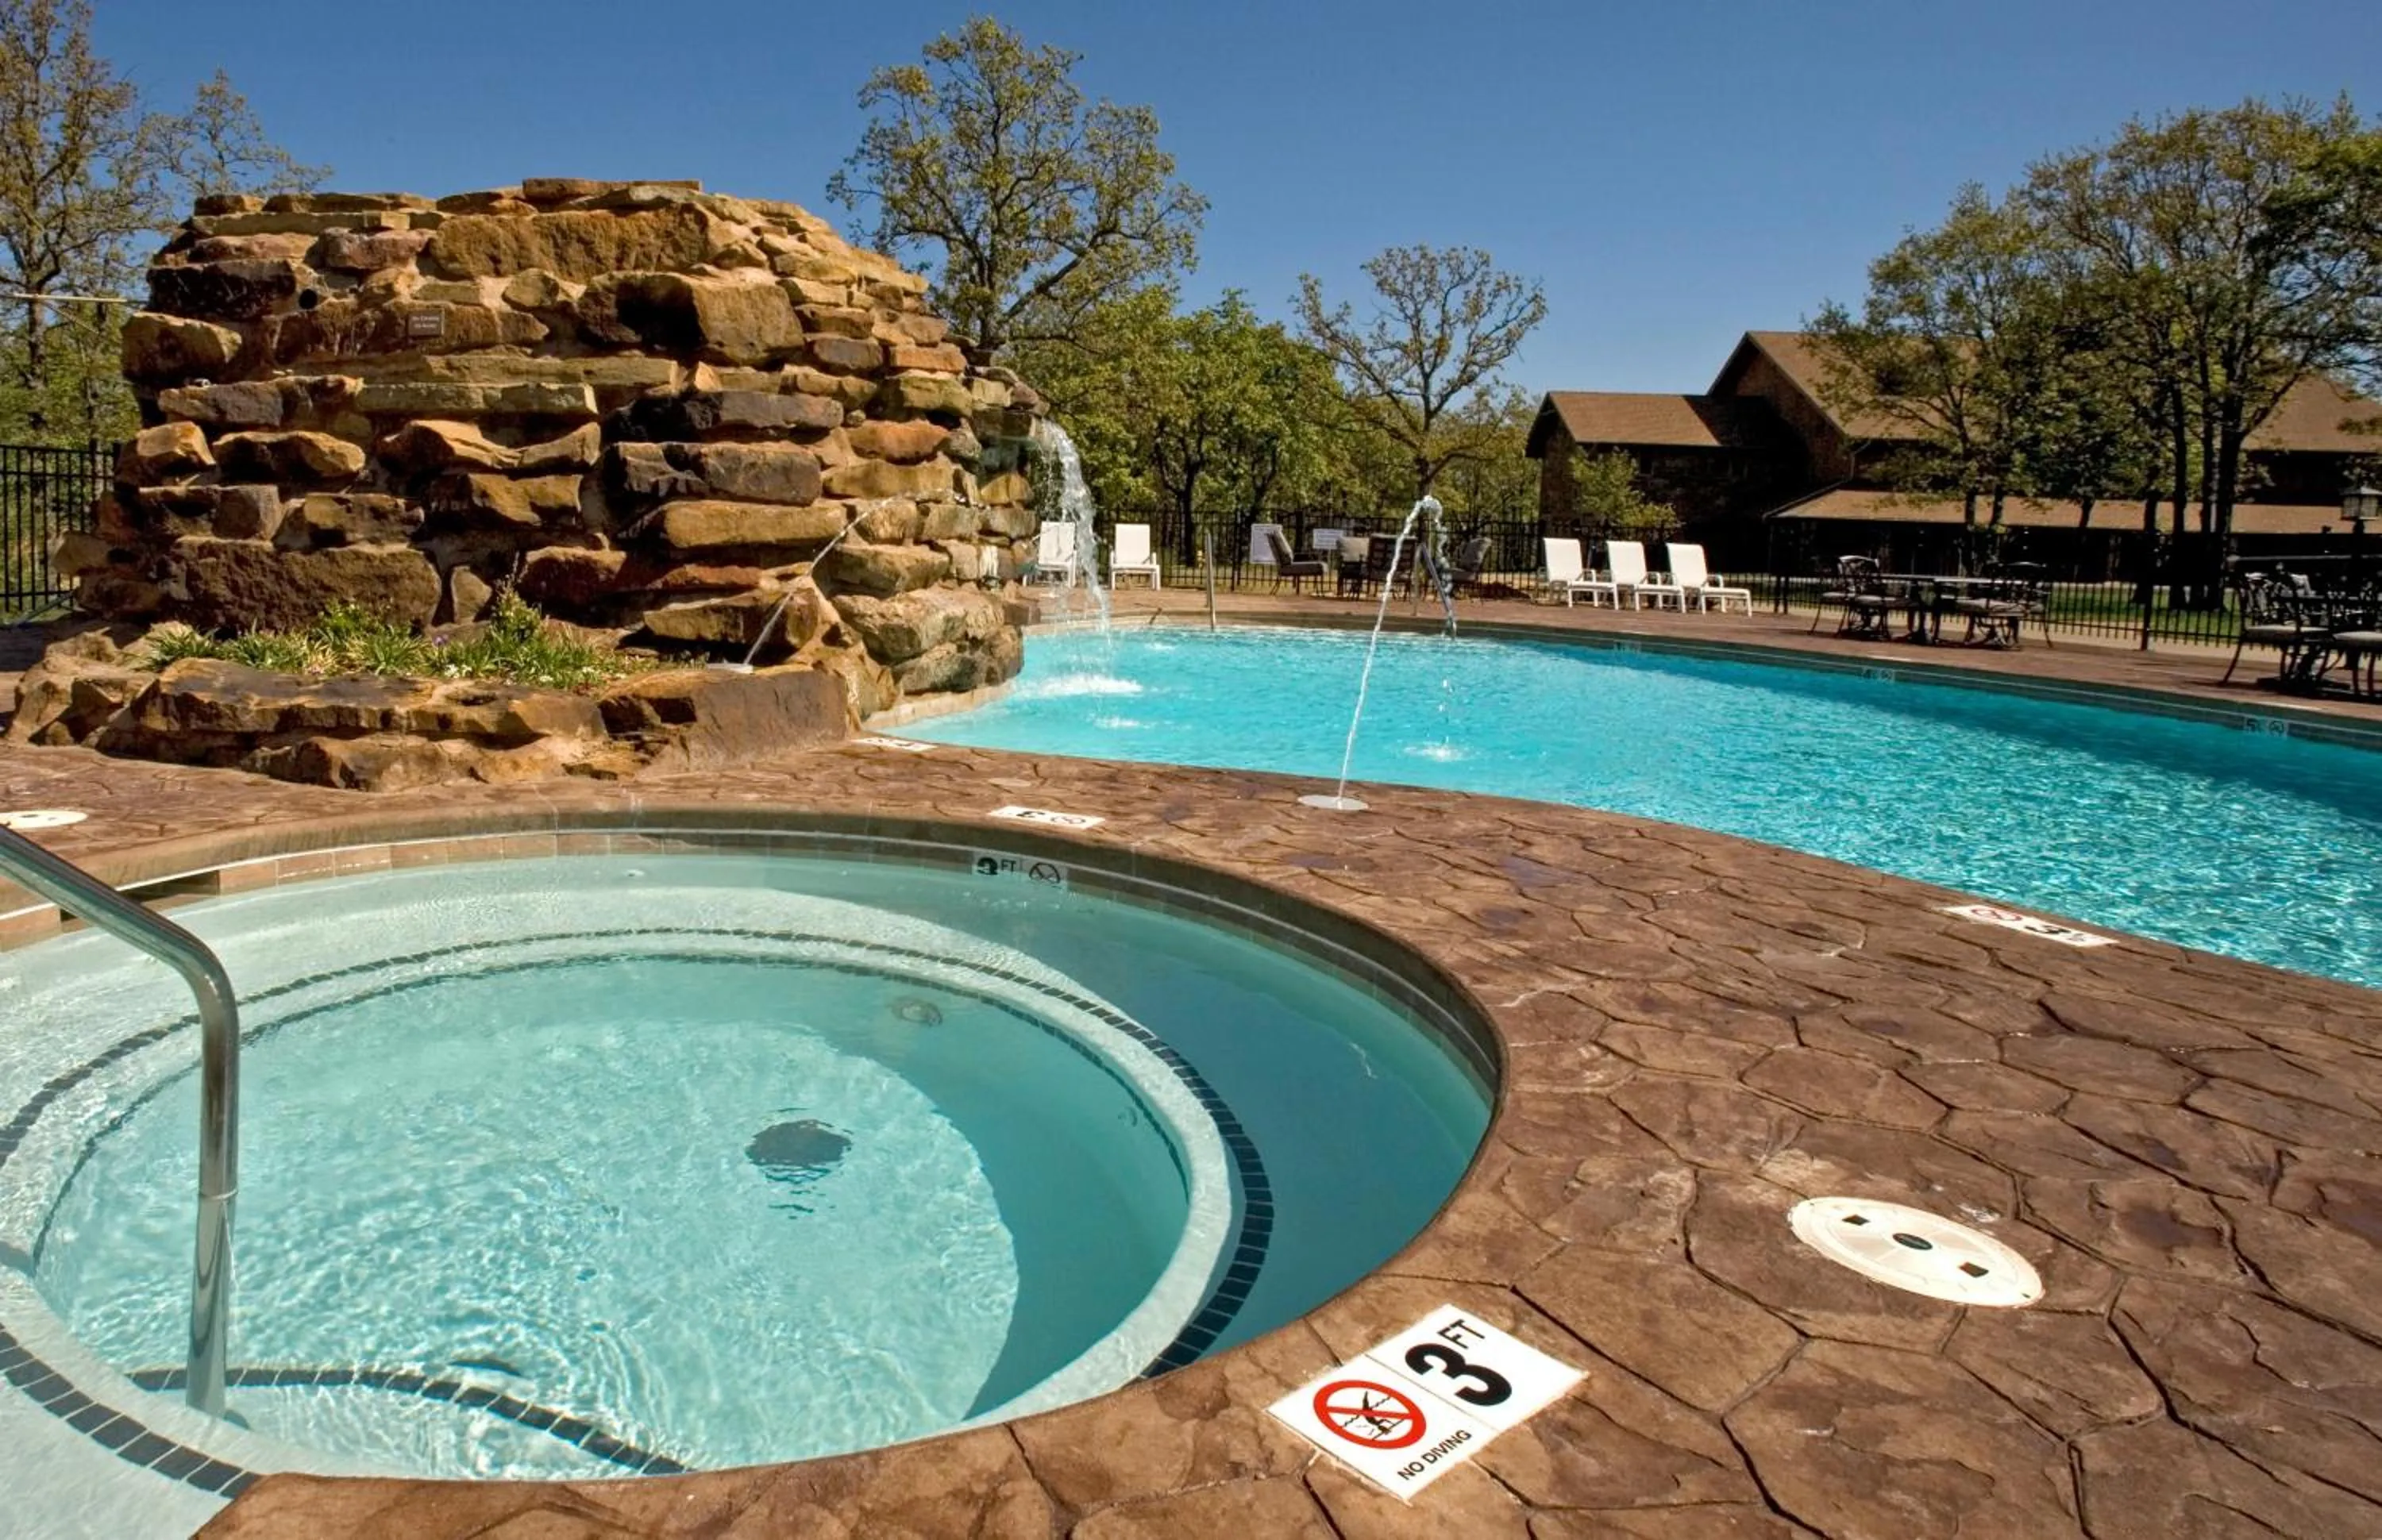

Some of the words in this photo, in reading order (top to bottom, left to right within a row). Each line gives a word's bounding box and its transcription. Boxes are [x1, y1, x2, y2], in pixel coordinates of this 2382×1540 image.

[977, 857, 998, 876] 3
[1000, 859, 1017, 872] FT
[1436, 1319, 1485, 1349] FT
[1405, 1343, 1513, 1407] 3
[1397, 1461, 1425, 1481] NO
[1420, 1430, 1473, 1465] DIVING
